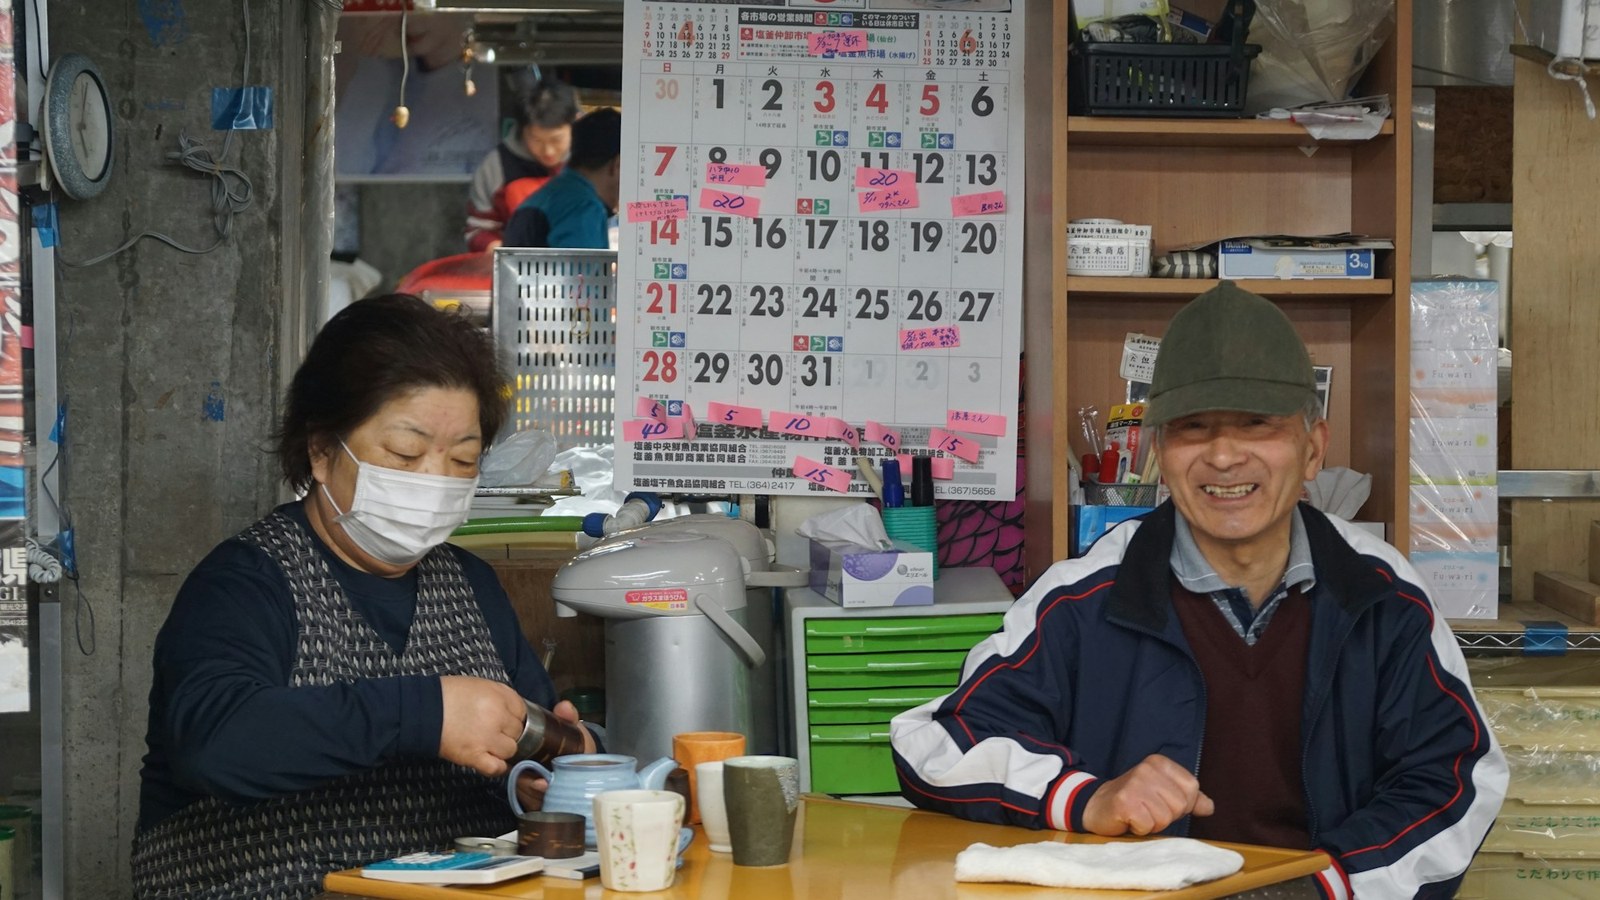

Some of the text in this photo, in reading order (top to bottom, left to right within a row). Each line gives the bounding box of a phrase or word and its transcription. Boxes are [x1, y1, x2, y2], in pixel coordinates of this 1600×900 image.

[740, 11, 813, 24] 各市場の営業時間
[663, 62, 989, 82] 日 月 火 水 木 金 土
[656, 78, 994, 116] 30 1 2 3 4 5 6
[654, 146, 678, 176] 7
[759, 148, 782, 179] 9
[807, 150, 841, 182] 10
[913, 152, 944, 184] 12
[966, 154, 998, 186] 13
[869, 172, 898, 186] 20
[713, 194, 744, 208] 20
[650, 216, 997, 254] 14 15 16 17 18 19 20
[1082, 246, 1125, 255] 但木商店
[646, 282, 995, 322] 21 22 23 24 25 26 27
[642, 350, 981, 386] 28 29 30 31 1 2 3
[724, 410, 738, 421] 5
[784, 418, 811, 430] 10
[633, 452, 746, 464] 塩釜魚類卸商業協同組合
[804, 468, 833, 483] 15
[632, 478, 726, 489] 塩釜塩干魚食品協同組合
[935, 486, 996, 496] EL.(367)5656
[1516, 868, 1600, 880] こだわりで作
